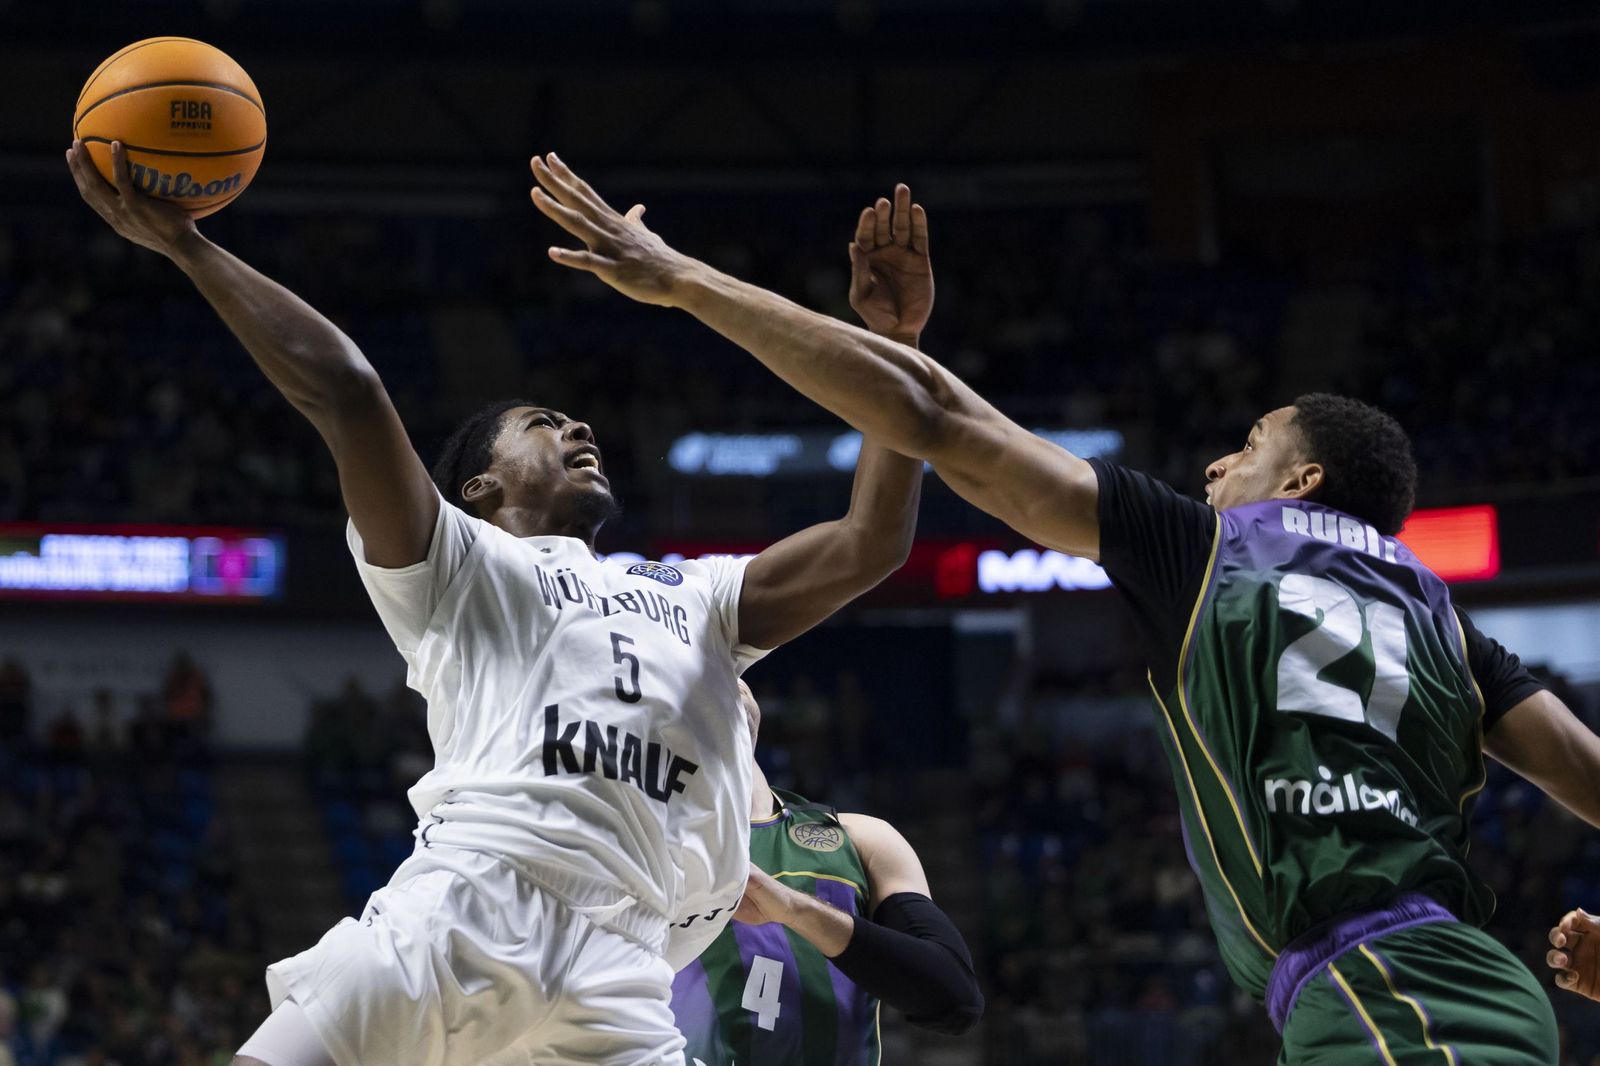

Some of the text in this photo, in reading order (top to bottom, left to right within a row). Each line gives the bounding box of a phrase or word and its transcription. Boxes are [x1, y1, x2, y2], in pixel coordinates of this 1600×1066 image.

[171, 100, 212, 119] FIBA
[127, 160, 242, 197] Wilson
[534, 564, 691, 646] WÜRZBURG
[610, 632, 642, 703] 5
[1276, 573, 1409, 744] 21
[542, 704, 699, 804] KNAUF
[741, 955, 784, 1032] 4
